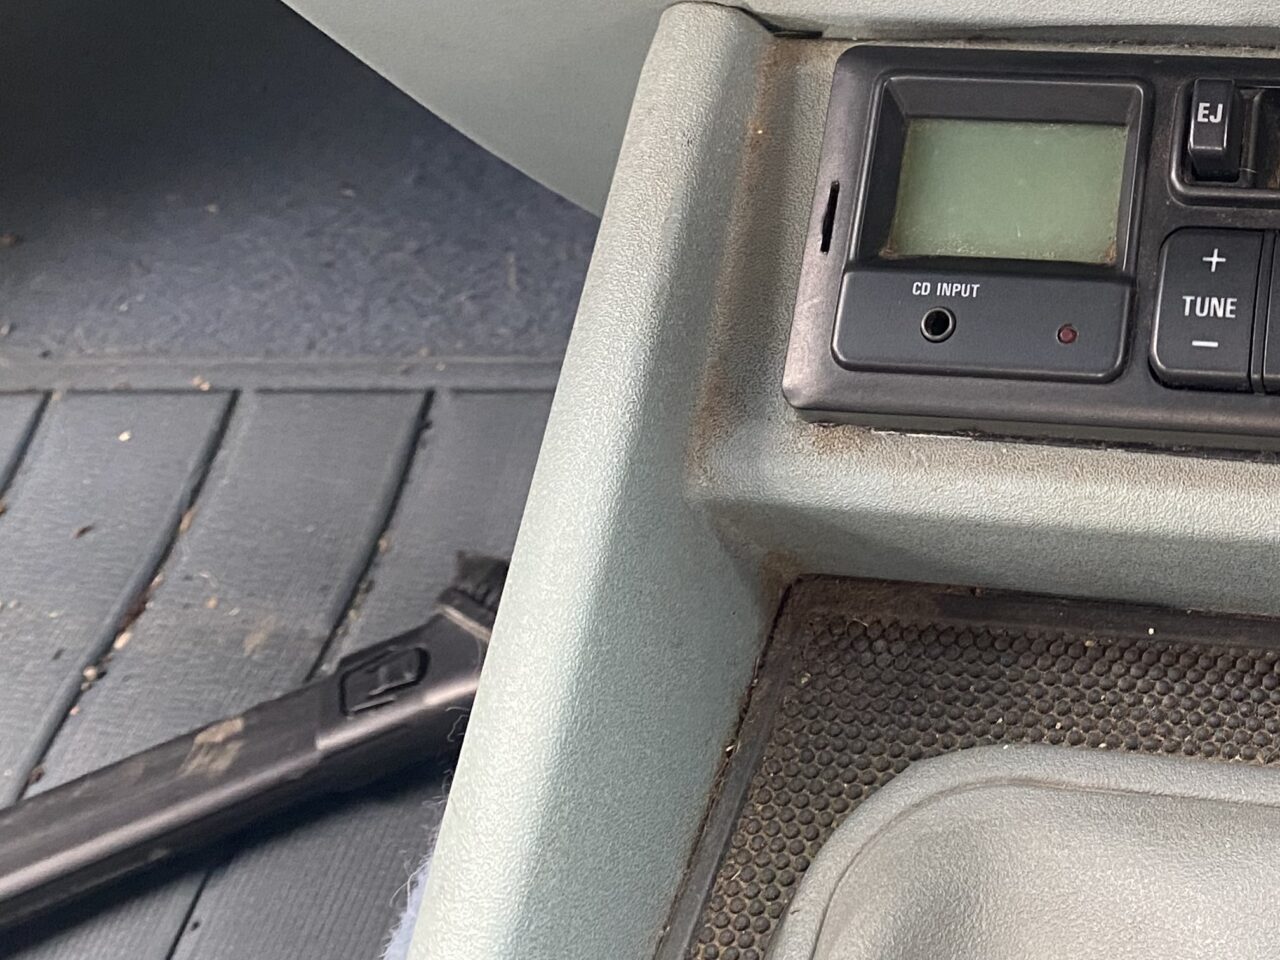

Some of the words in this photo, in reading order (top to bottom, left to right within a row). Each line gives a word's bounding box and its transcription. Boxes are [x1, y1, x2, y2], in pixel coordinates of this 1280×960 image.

[1197, 102, 1224, 124] EJ
[912, 281, 931, 296] CD
[936, 282, 981, 298] INPUT
[1182, 295, 1238, 319] TUNE
